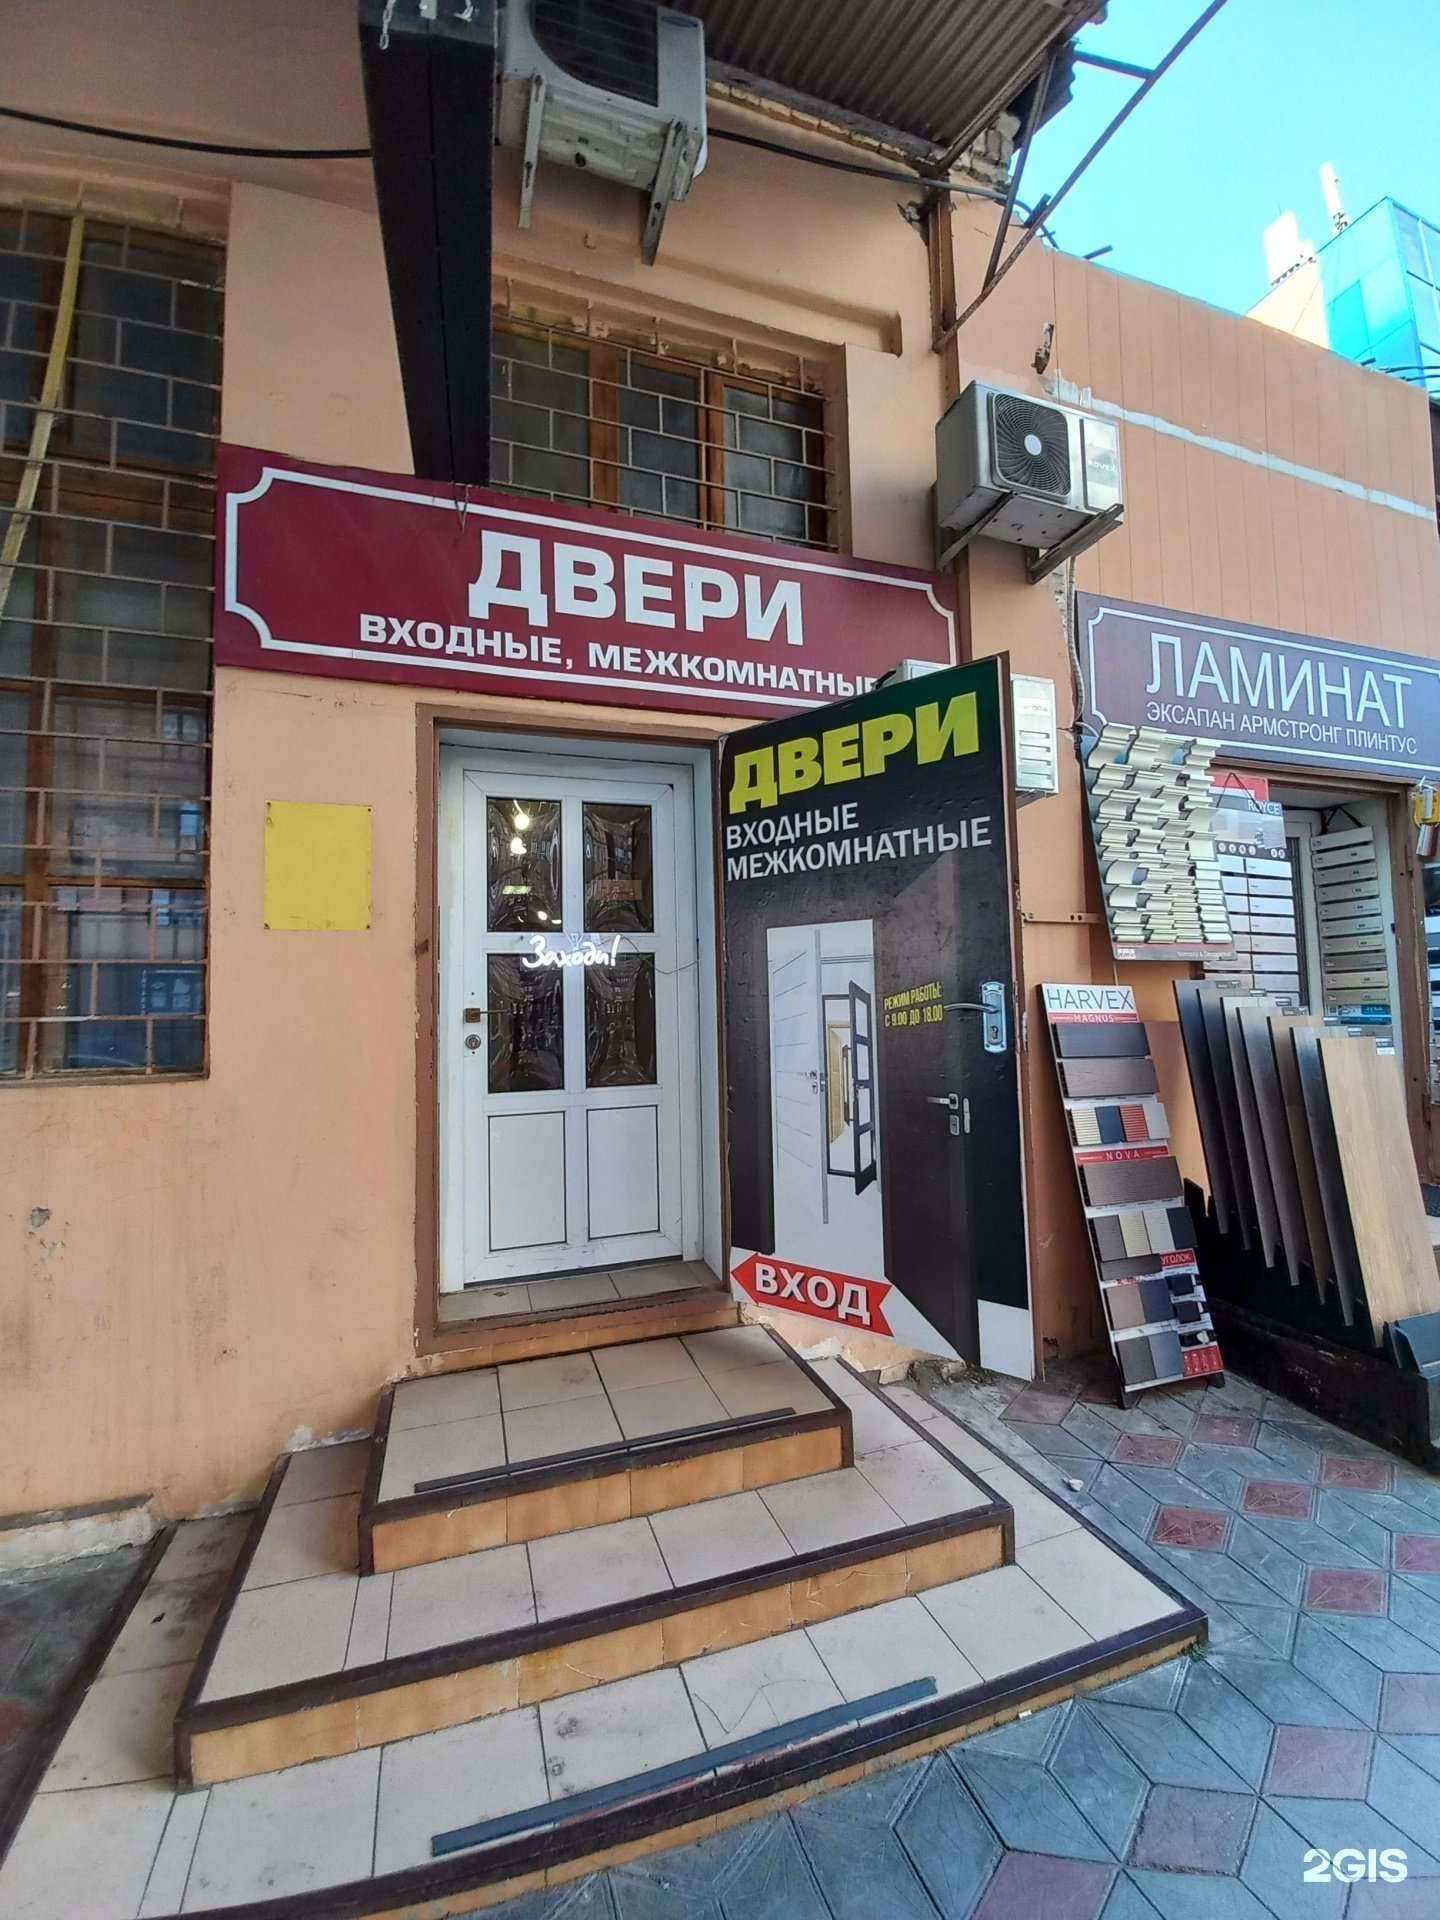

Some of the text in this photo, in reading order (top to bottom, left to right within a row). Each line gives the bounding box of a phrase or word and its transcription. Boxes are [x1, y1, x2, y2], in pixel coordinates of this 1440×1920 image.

[468, 529, 804, 646] ДВЕРИ
[359, 612, 573, 670] ВХОДНЫЕ,
[1146, 632, 1412, 729] ЛАМИНАТ
[1147, 701, 1417, 755] ЭКСАПАН АРМСТРОНГ ПЛИНТУС
[729, 691, 980, 815] ДВЕРИ
[726, 802, 860, 850] ВХОДНЫЕ
[727, 816, 993, 882] МЕЖКОМНАТНЫЕ
[522, 934, 621, 969] Заходи!
[884, 991, 910, 1011] РЕЖИМ
[884, 1014, 890, 1028] С
[909, 1008, 920, 1026] ДО
[922, 1004, 943, 1023] 18.00
[1047, 988, 1134, 1010] HARVEX
[1073, 1013, 1115, 1023] MAGNUS
[1105, 1150, 1141, 1161] NOVA
[1161, 1253, 1192, 1265] УГОЛОК
[755, 1262, 871, 1326] ВХОД
